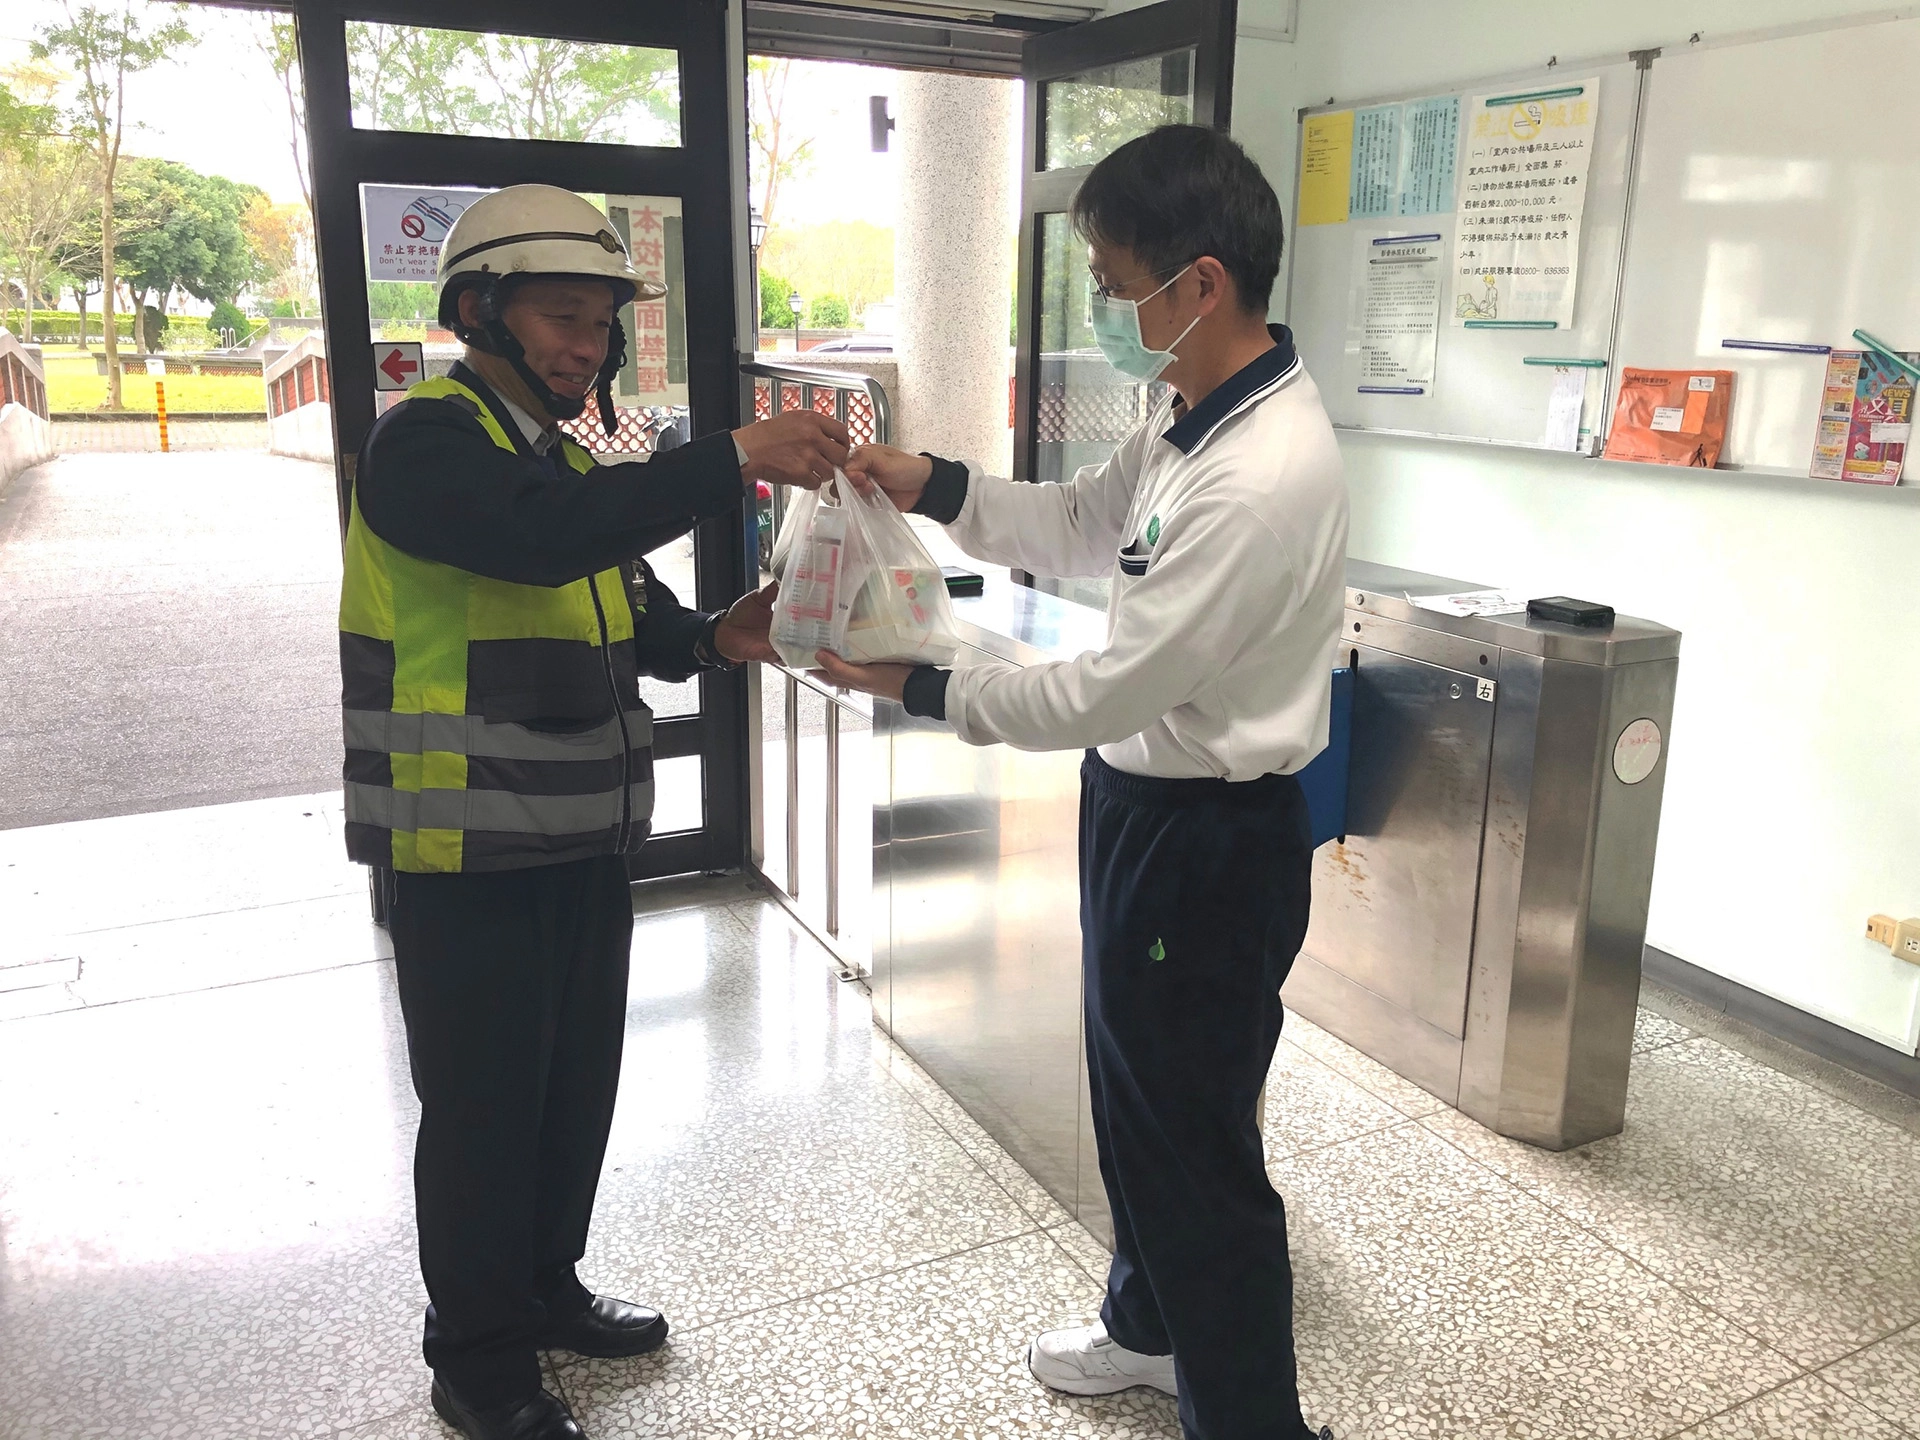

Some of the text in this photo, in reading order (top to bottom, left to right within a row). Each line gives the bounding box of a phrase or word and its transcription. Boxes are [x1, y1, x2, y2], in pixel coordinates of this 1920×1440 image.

[384, 243, 440, 256] 禁止穿拖鞋
[379, 256, 403, 265] Don't
[396, 266, 406, 274] of
[411, 267, 426, 275] the
[1478, 683, 1492, 699] 右
